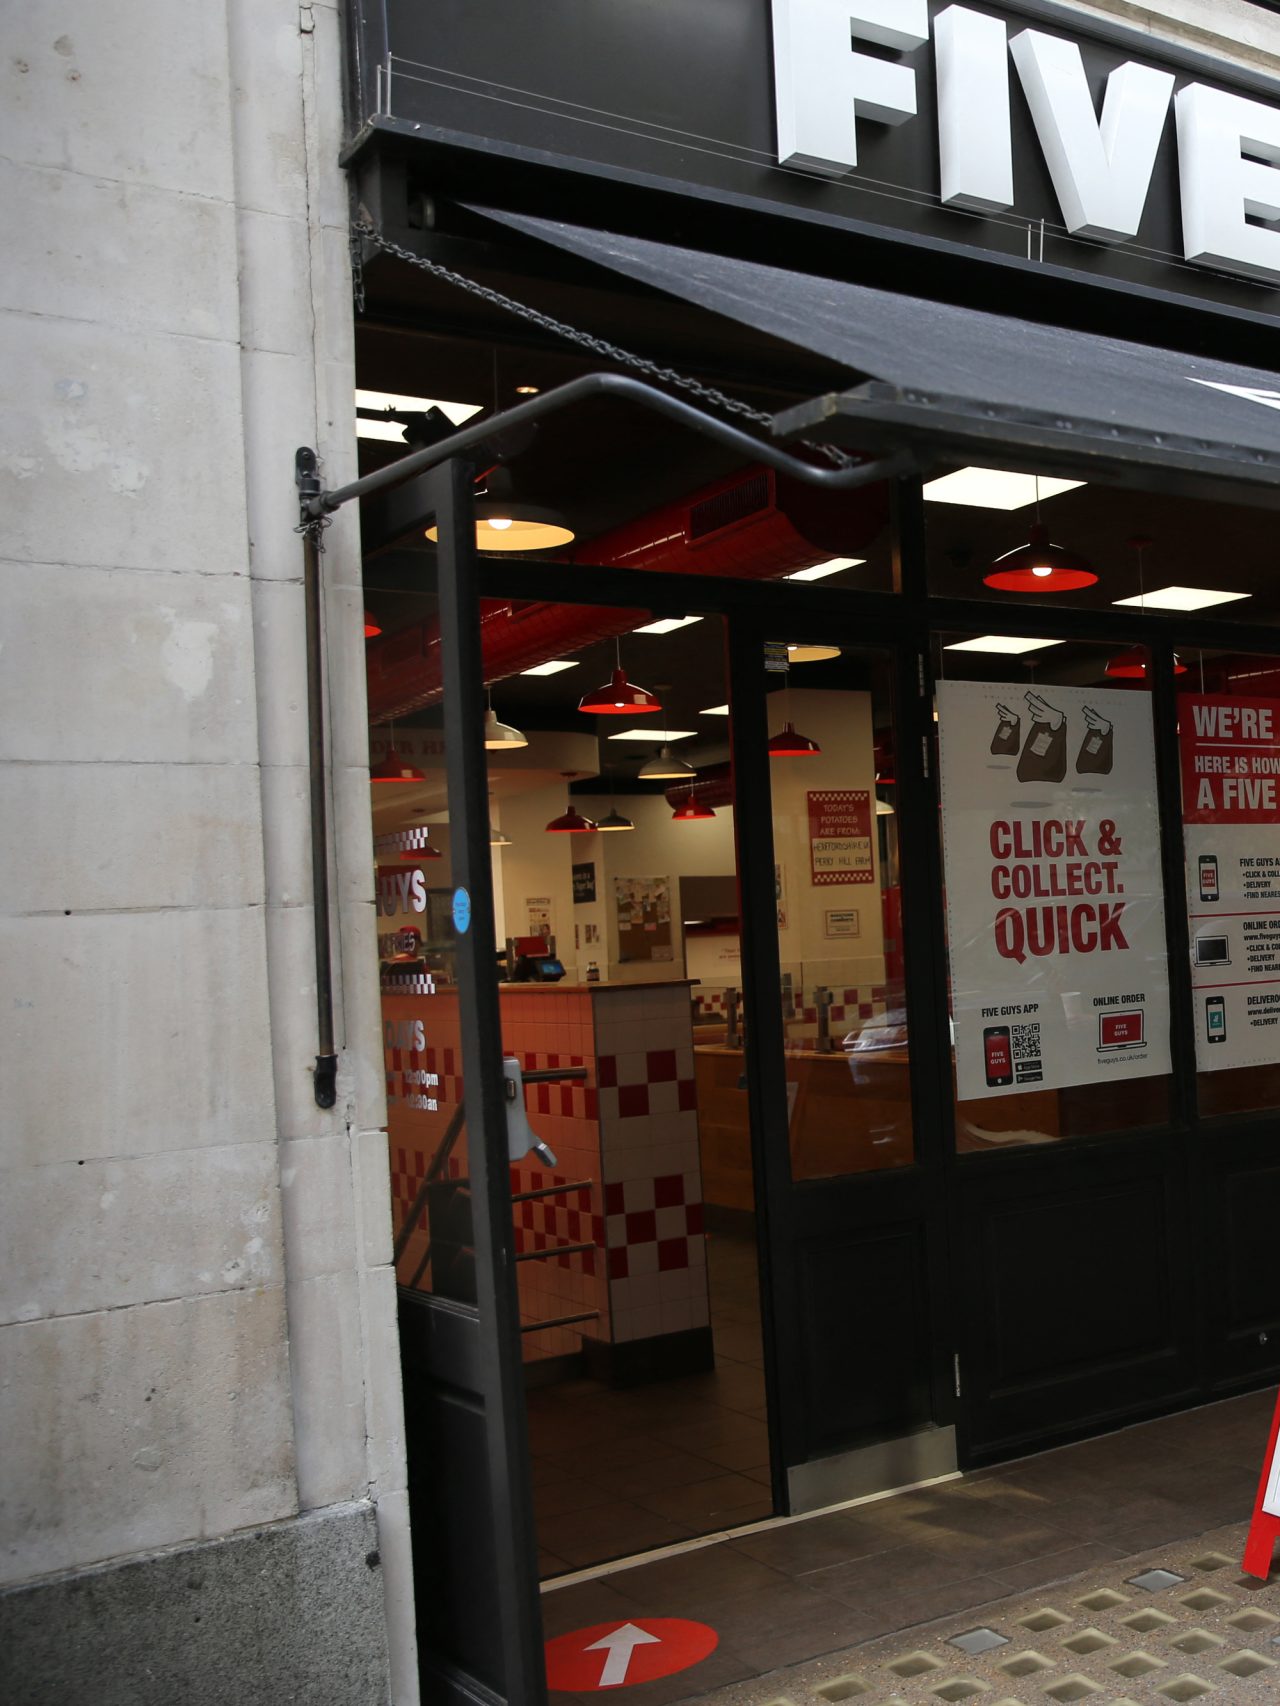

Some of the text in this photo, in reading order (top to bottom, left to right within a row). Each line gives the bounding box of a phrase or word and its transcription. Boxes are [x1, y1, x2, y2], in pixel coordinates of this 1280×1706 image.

[1192, 705, 1274, 740] WE'RE
[1194, 755, 1231, 774] HERE
[1235, 756, 1248, 774] IS
[1196, 778, 1216, 810] A
[1222, 778, 1277, 810] FIVE
[823, 803, 854, 813] TODAY'S
[820, 815, 858, 824] POTATOES
[820, 827, 836, 836] ARE
[989, 818, 1123, 860] CLICK &
[1240, 858, 1255, 867] FIVE
[1256, 858, 1274, 867] GUYS
[991, 861, 1125, 900] COLLECT.
[376, 868, 427, 917] UYS
[994, 902, 1130, 965] QUICK
[1243, 921, 1268, 931] ONLINE
[1093, 993, 1146, 1007] ONLINE ORDER
[982, 1003, 1039, 1018] FIVE GUYS APP
[990, 1057, 1006, 1065] GUYS
